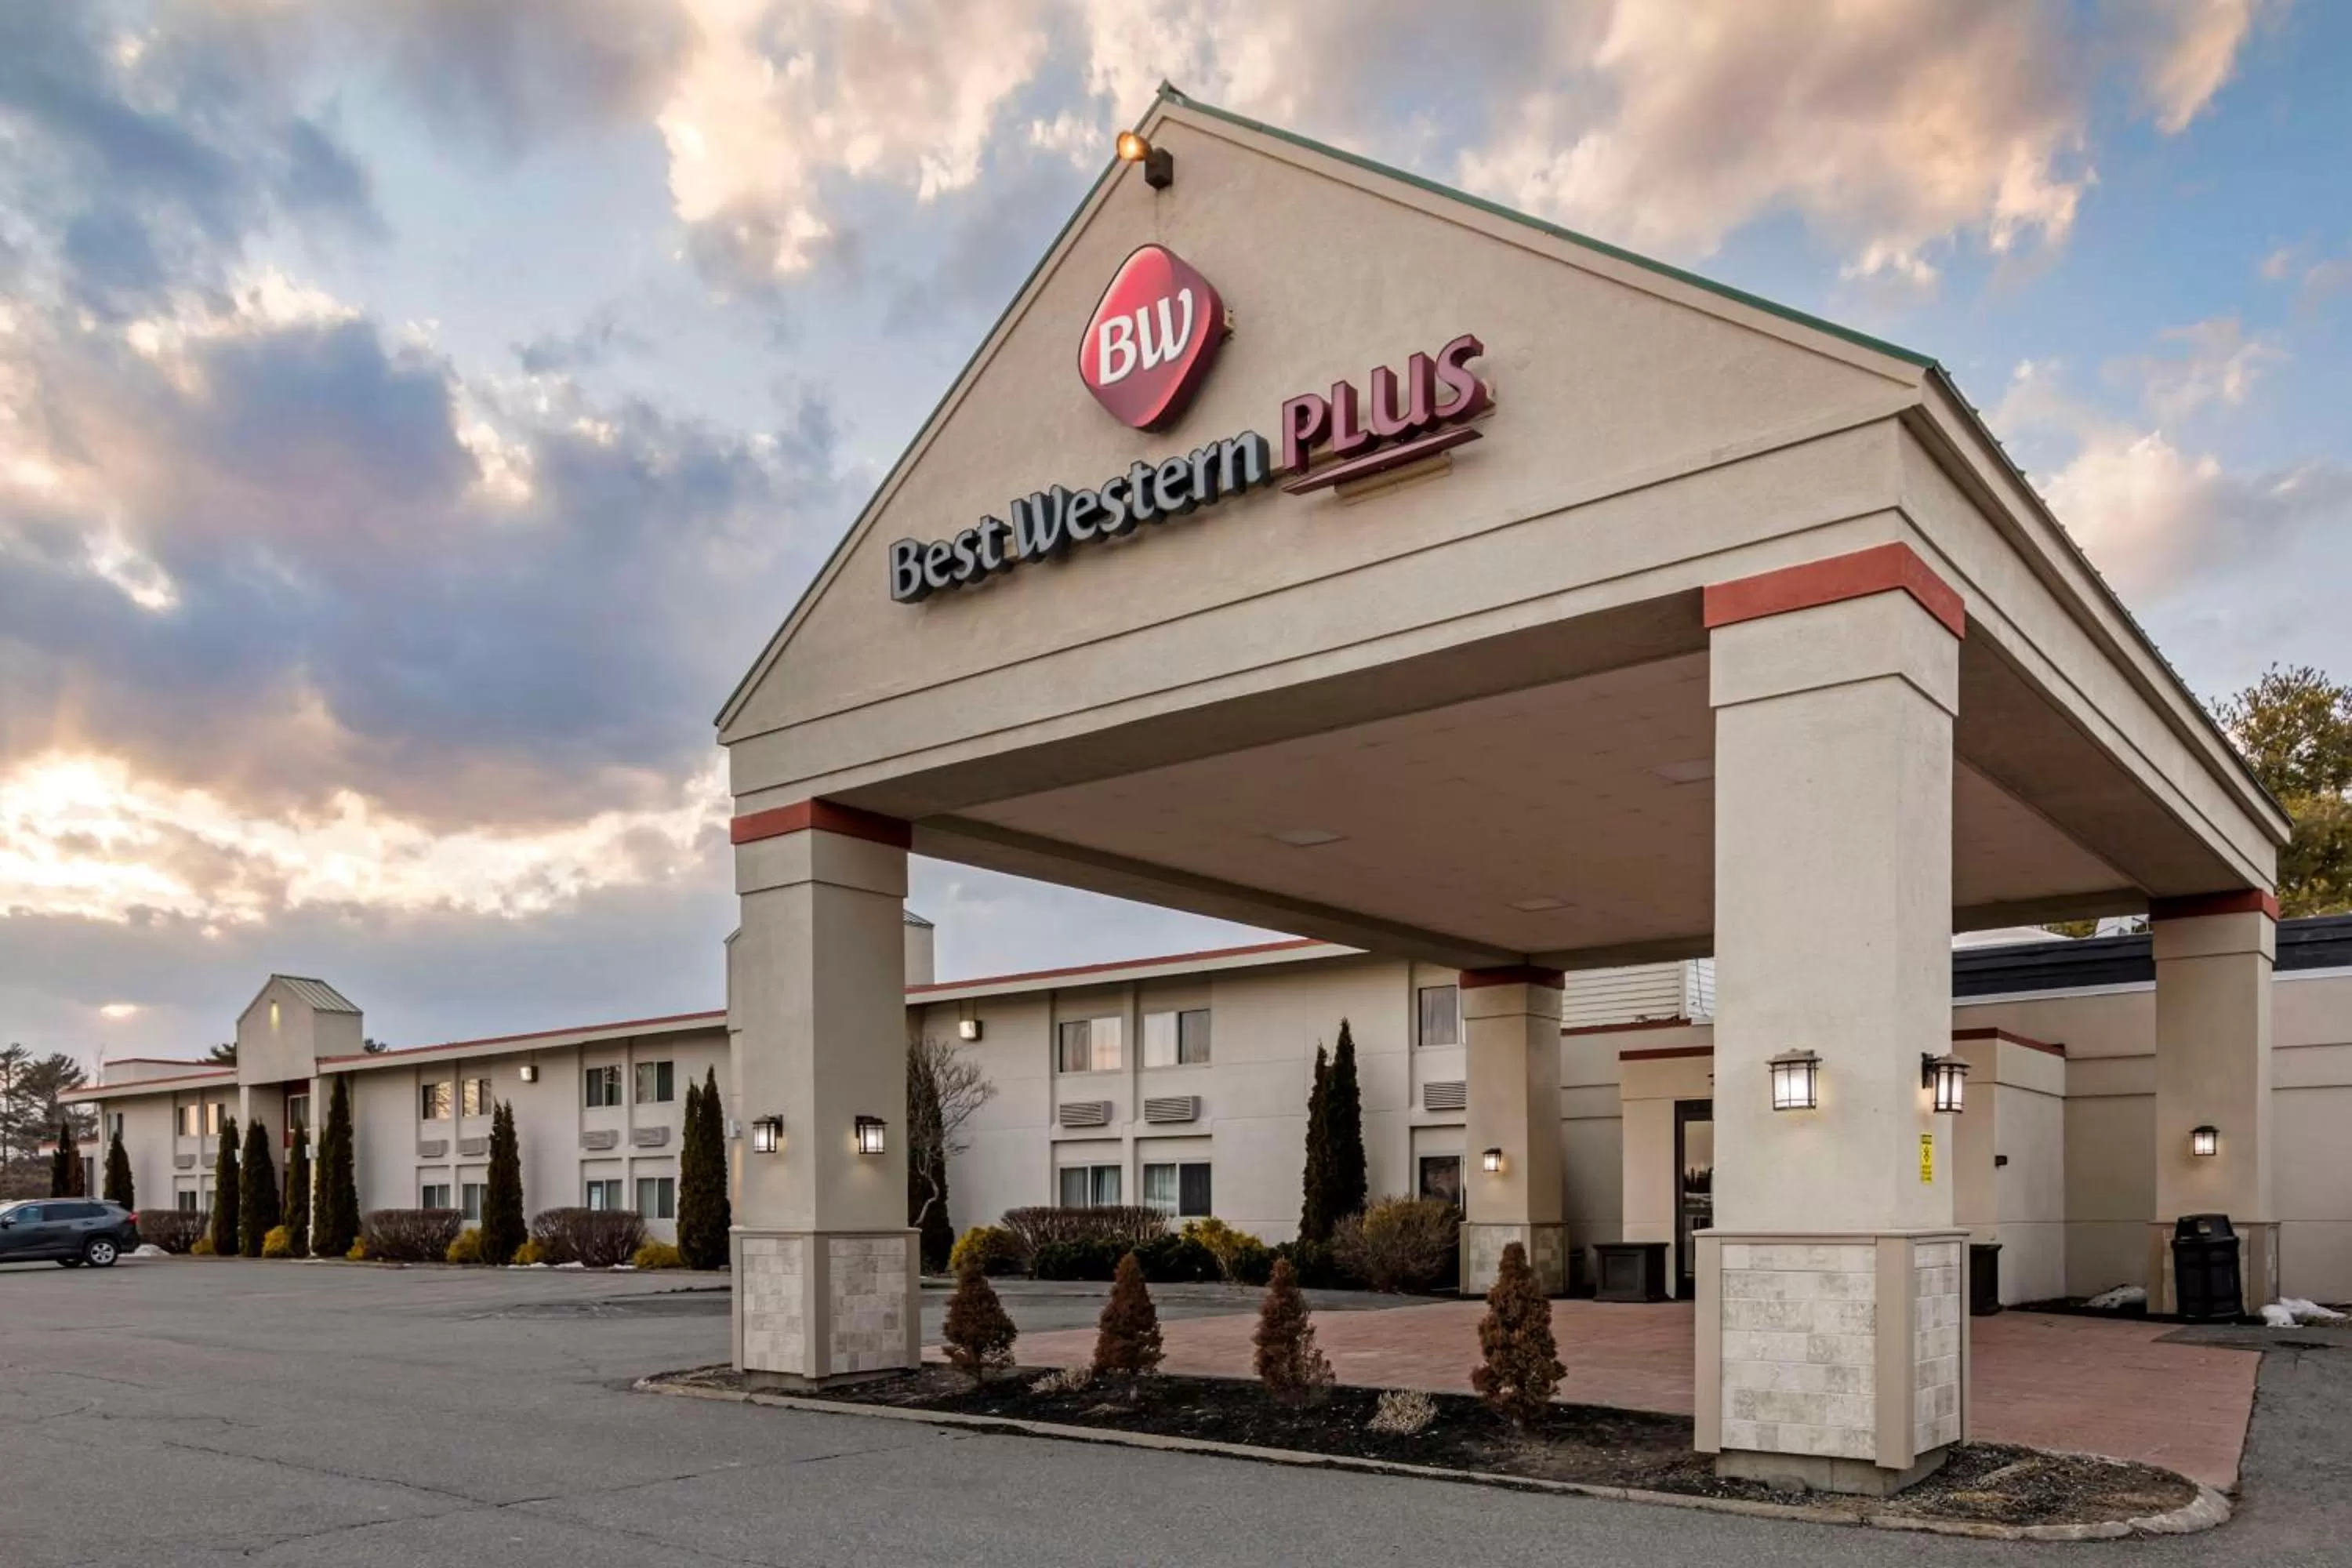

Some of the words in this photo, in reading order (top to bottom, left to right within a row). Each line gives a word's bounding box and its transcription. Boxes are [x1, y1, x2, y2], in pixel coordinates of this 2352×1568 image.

[1098, 289, 1193, 385] BW
[890, 516, 1006, 603] Best
[1011, 430, 1269, 558] Western
[1283, 334, 1486, 470] PLUS
